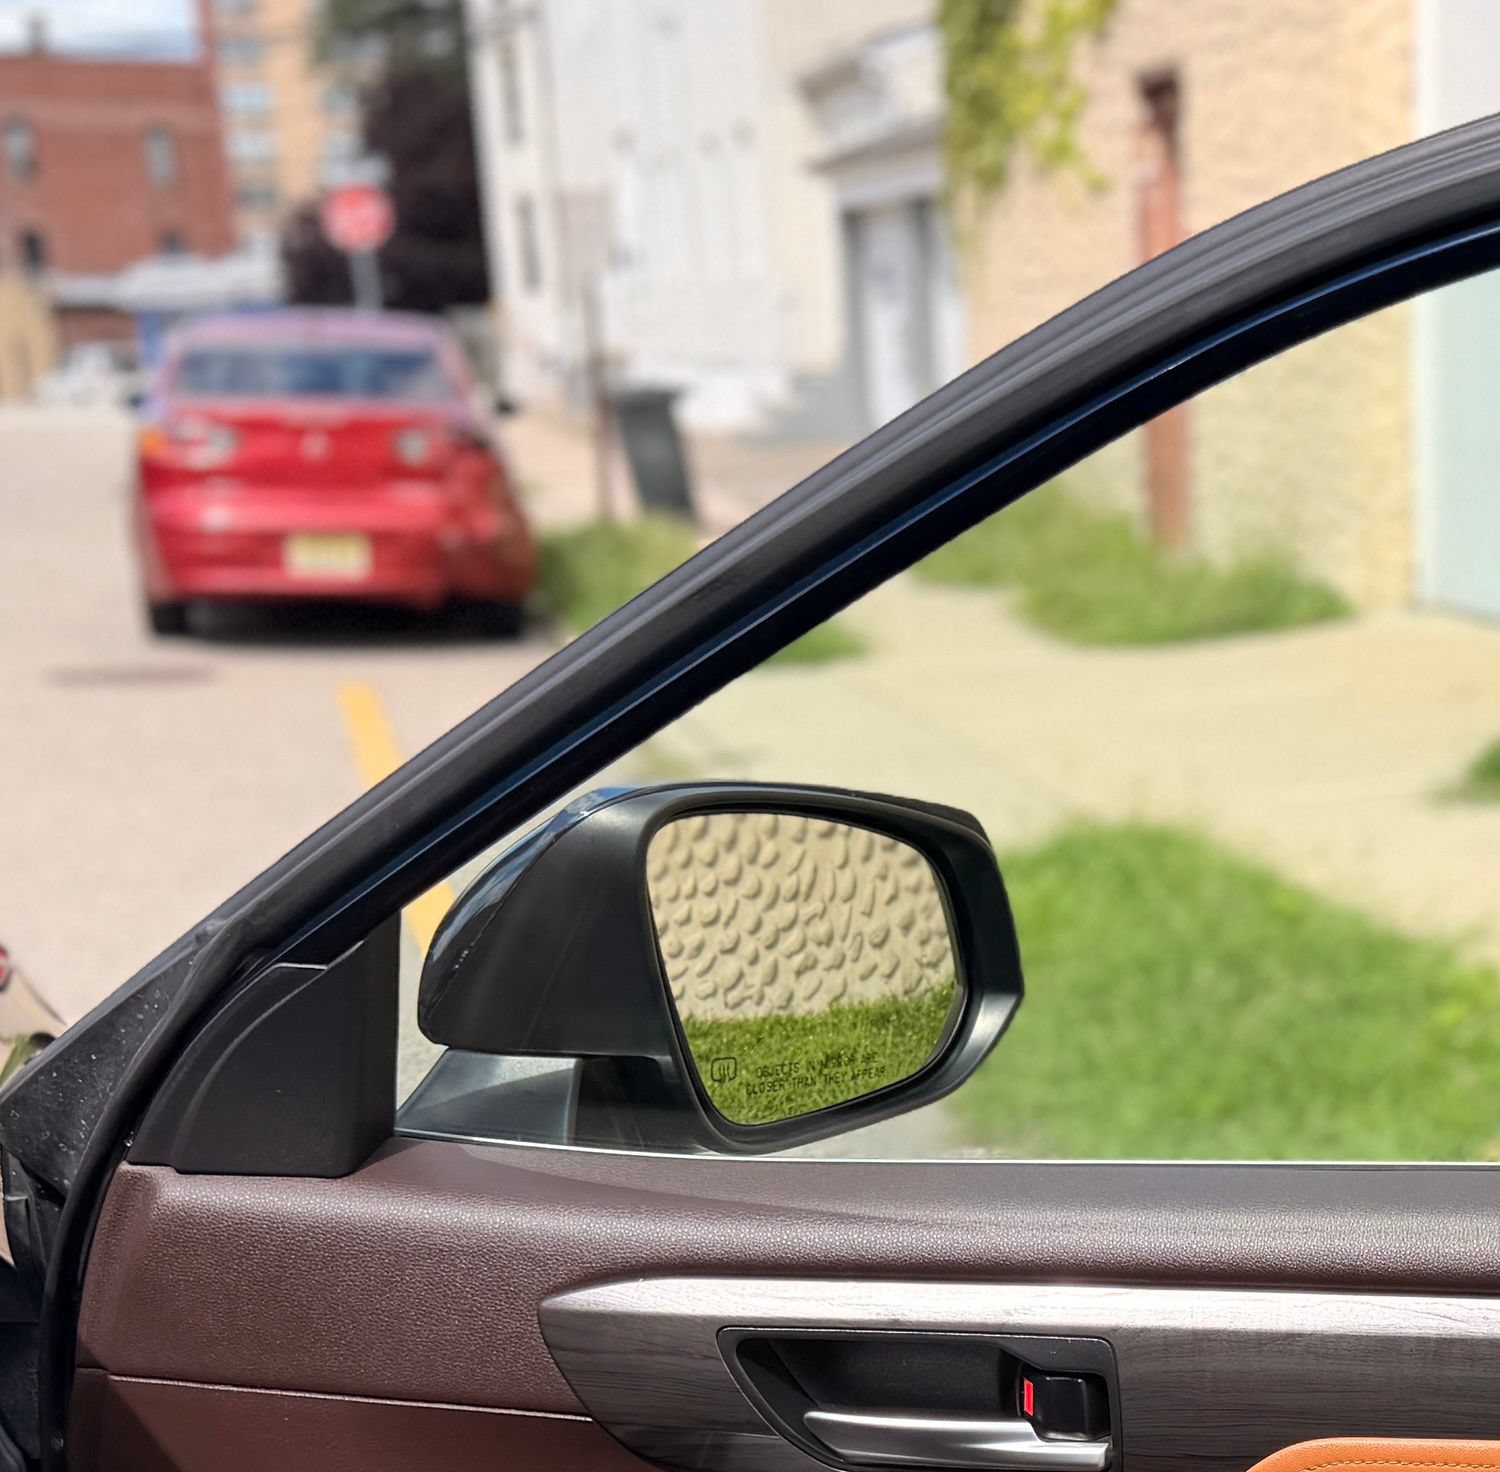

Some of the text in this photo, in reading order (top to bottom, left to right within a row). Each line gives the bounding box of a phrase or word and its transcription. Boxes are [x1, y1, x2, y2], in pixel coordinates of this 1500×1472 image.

[755, 1062, 800, 1079] OBJECTS
[807, 1060, 815, 1072] IN
[861, 1052, 878, 1064] ARE
[746, 1065, 886, 1096] CLOSER THAN THEY APPEAR
